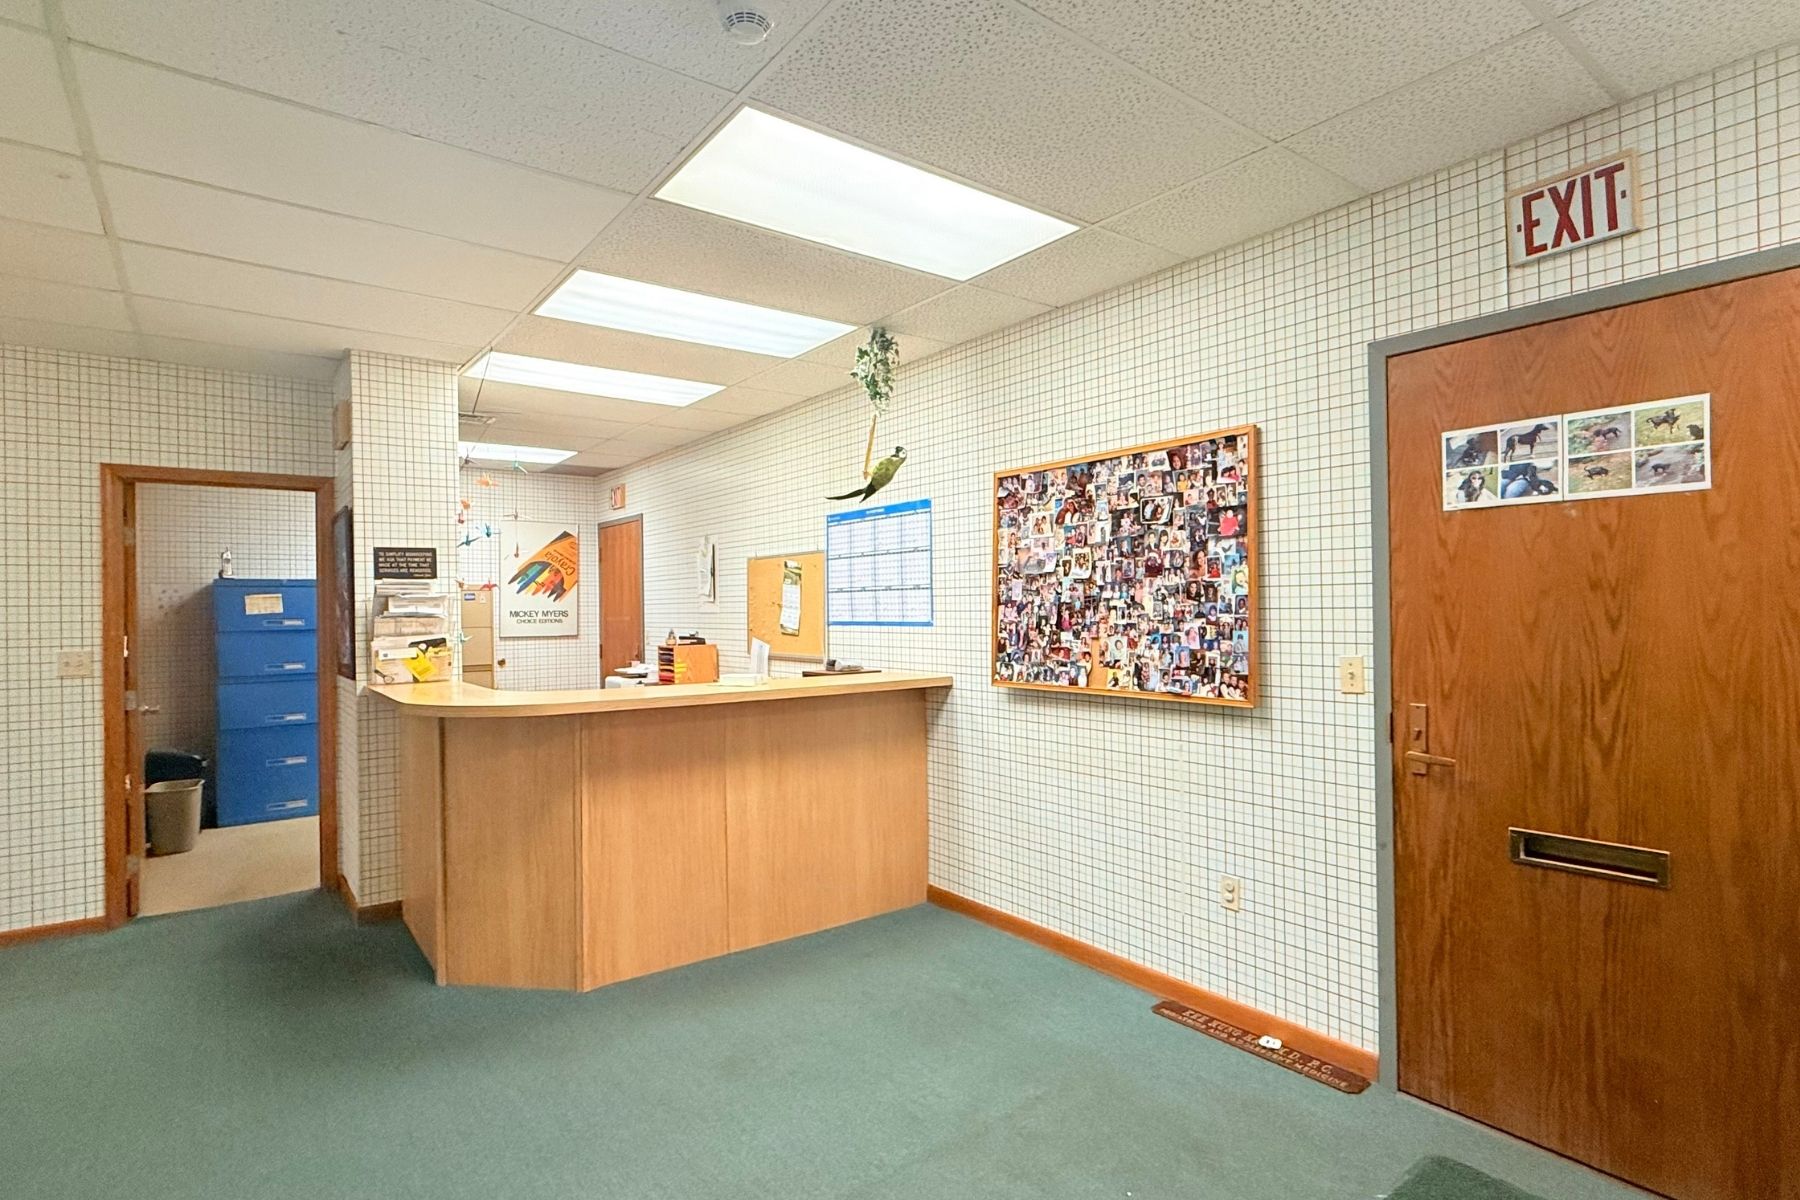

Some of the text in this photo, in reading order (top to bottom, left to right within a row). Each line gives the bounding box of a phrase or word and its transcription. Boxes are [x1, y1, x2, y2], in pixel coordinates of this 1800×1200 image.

[1522, 162, 1624, 257] EXIT
[544, 550, 576, 577] Crayola
[509, 610, 569, 618] MICKEY MYERS
[1294, 1062, 1349, 1088] MEDICINE
